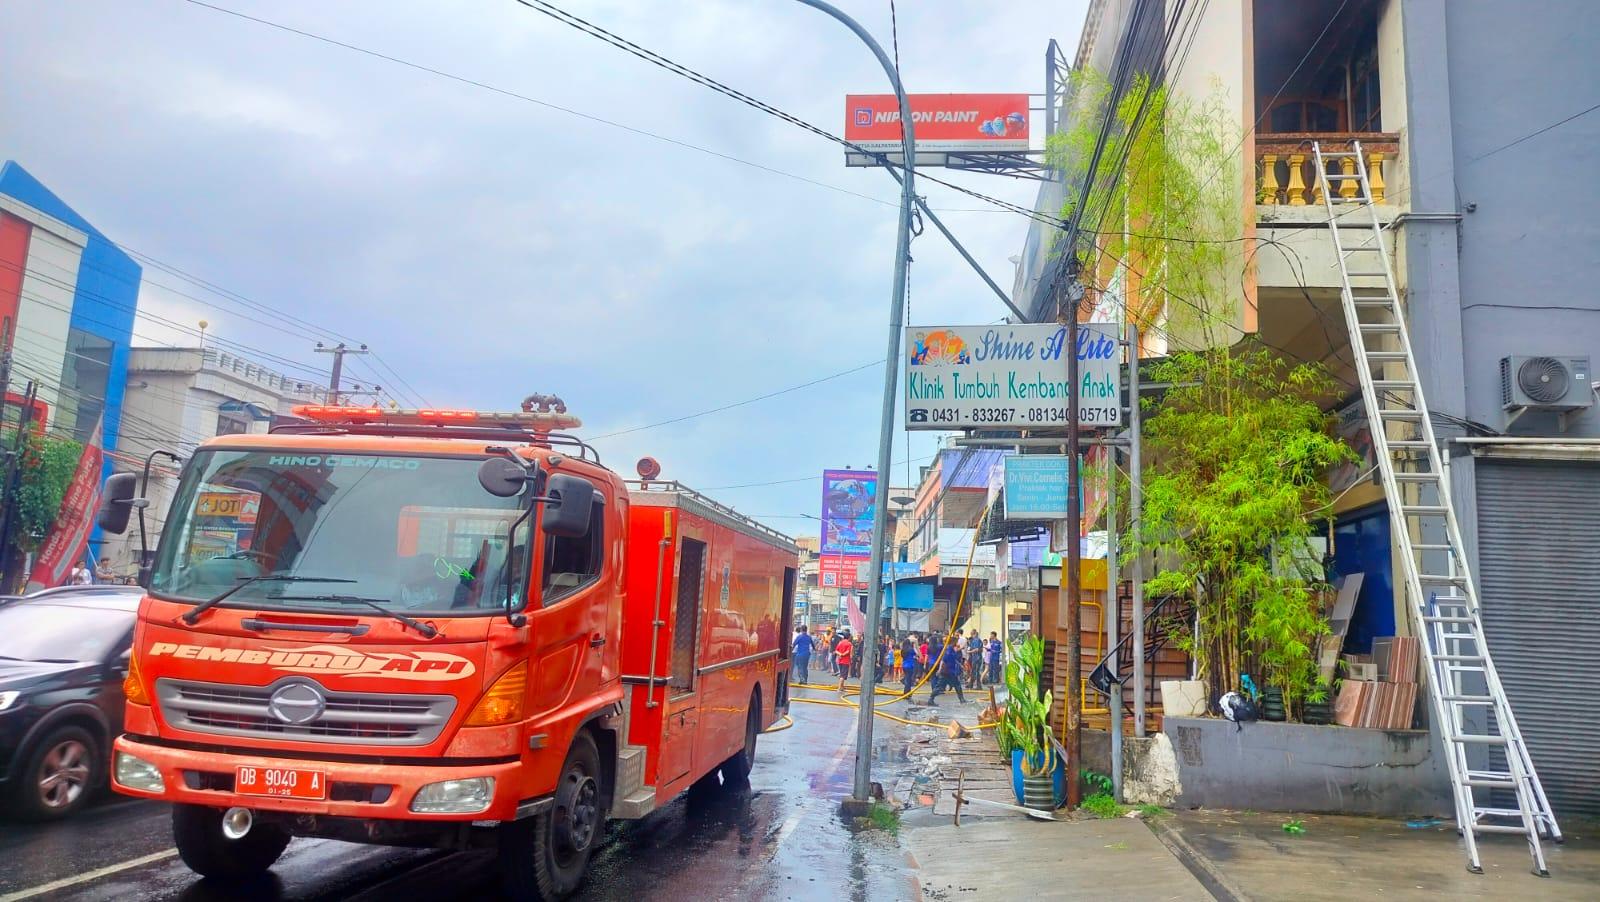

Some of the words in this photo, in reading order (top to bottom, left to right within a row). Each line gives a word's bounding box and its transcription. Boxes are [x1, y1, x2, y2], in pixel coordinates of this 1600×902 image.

[875, 111, 933, 123] NIPON
[935, 111, 979, 122] PAINT
[975, 329, 1035, 361] Shine
[1041, 325, 1067, 361] A
[1075, 326, 1115, 361] Lite
[910, 372, 945, 399] Klinik
[953, 372, 1000, 399] Tumbuh
[1081, 371, 1115, 398] Anak
[932, 408, 960, 422] 0431
[972, 408, 1016, 422] 833267
[1028, 408, 1117, 422] 08134005719
[269, 456, 321, 466] HINO
[211, 499, 240, 513] JOT
[39, 530, 61, 565] Honda
[149, 642, 368, 670] PEMBURU
[380, 658, 468, 674] API
[240, 767, 257, 785] DB
[265, 769, 297, 787] 9040
[311, 772, 319, 790] A
